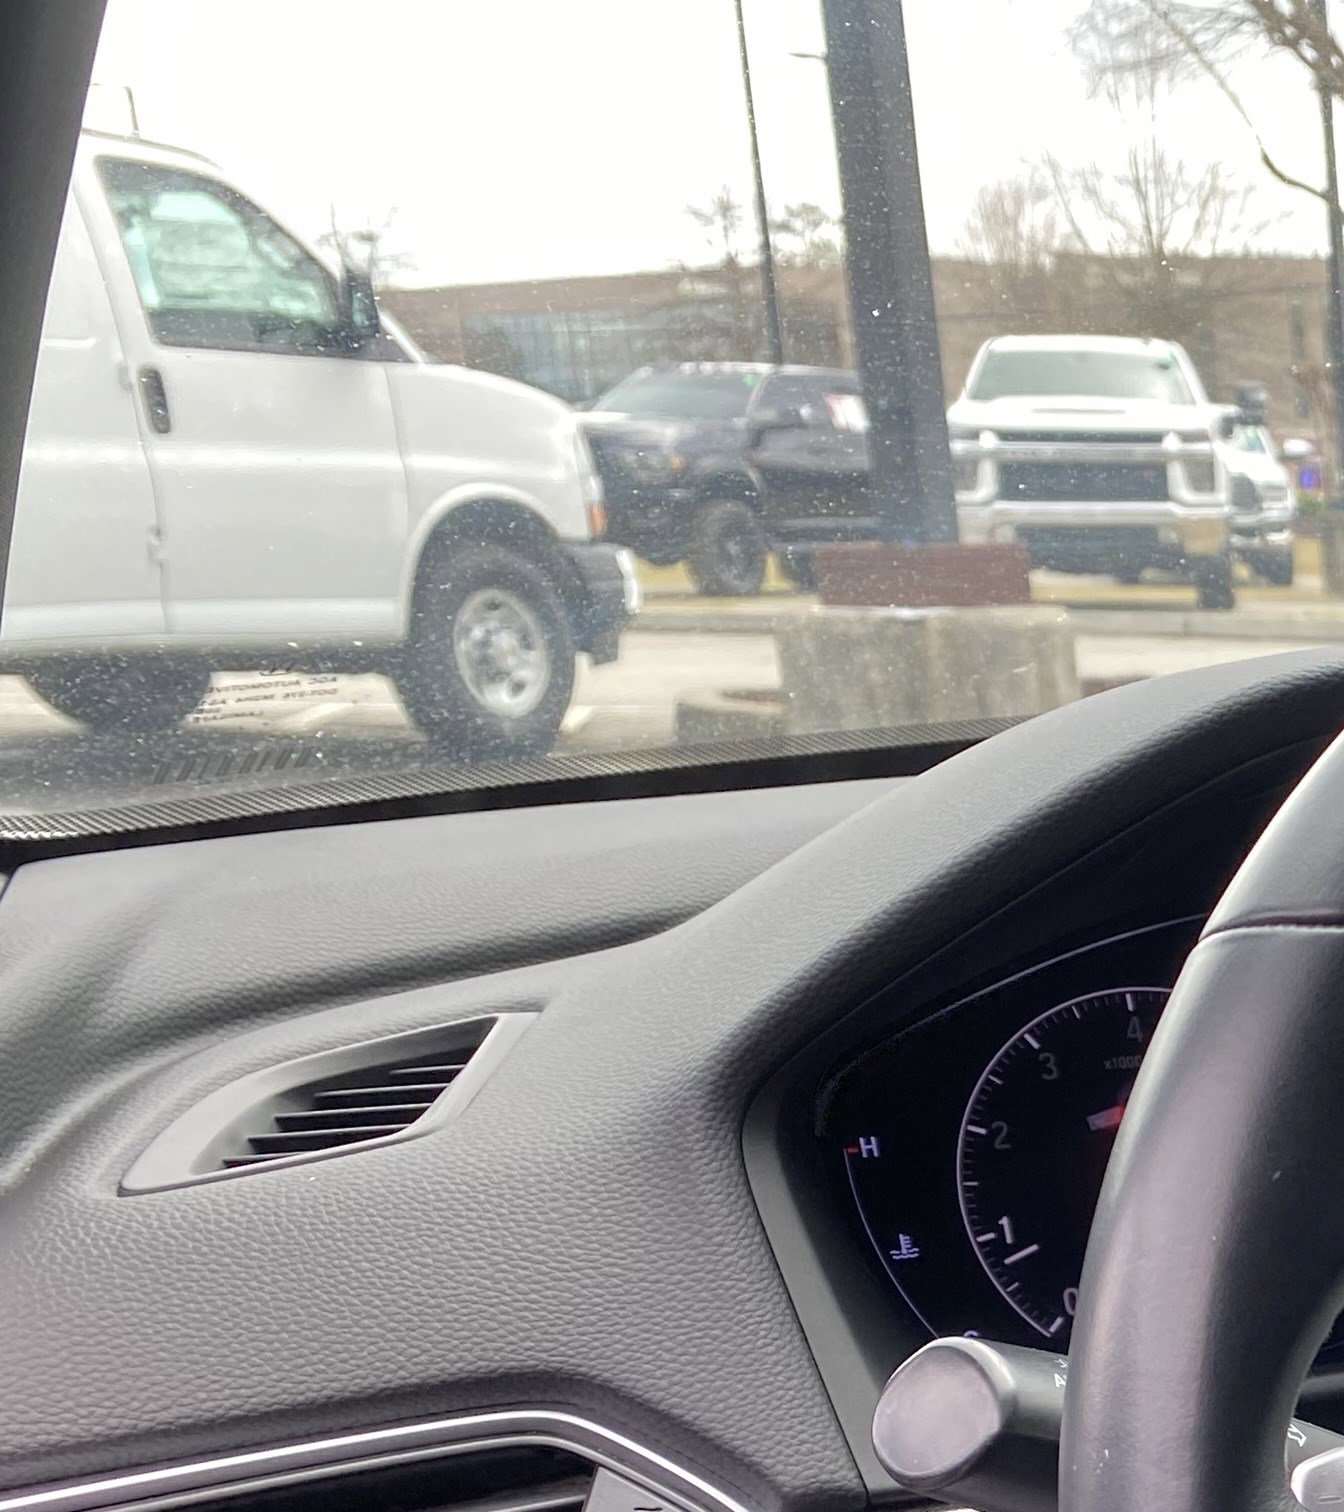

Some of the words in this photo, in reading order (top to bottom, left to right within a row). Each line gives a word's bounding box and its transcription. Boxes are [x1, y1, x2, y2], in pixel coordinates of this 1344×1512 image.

[1126, 1015, 1143, 1043] 4
[1038, 1051, 1059, 1081] 3
[859, 1136, 880, 1158] H
[990, 1120, 1012, 1150] 2
[998, 1215, 1013, 1245] 1
